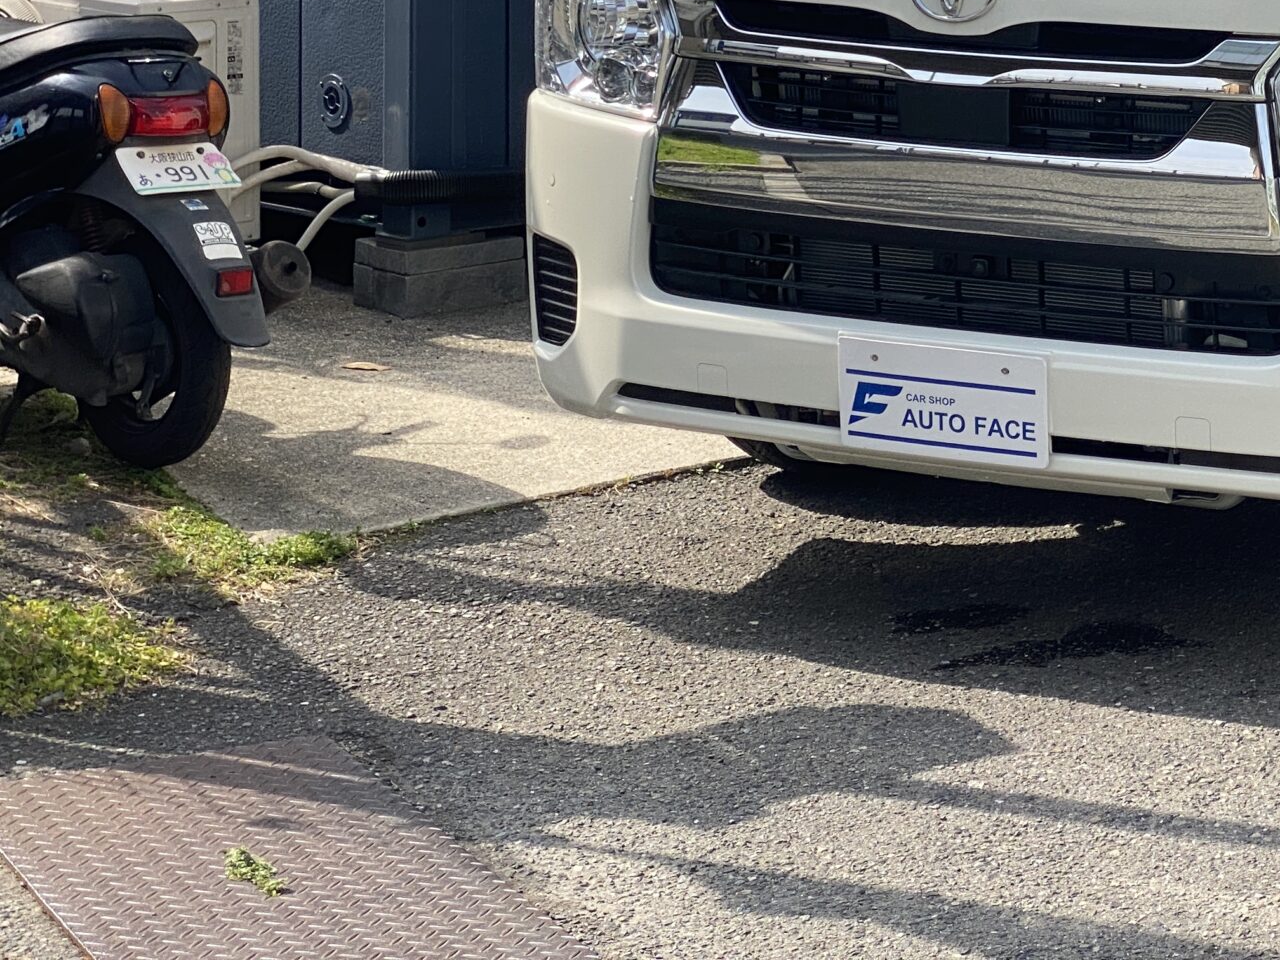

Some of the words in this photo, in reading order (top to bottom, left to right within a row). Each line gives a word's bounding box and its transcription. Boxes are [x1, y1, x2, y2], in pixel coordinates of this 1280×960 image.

[905, 392, 926, 404] CAR
[928, 395, 956, 407] SHOP
[901, 408, 966, 433] AUTO
[974, 416, 1036, 441] FACE
